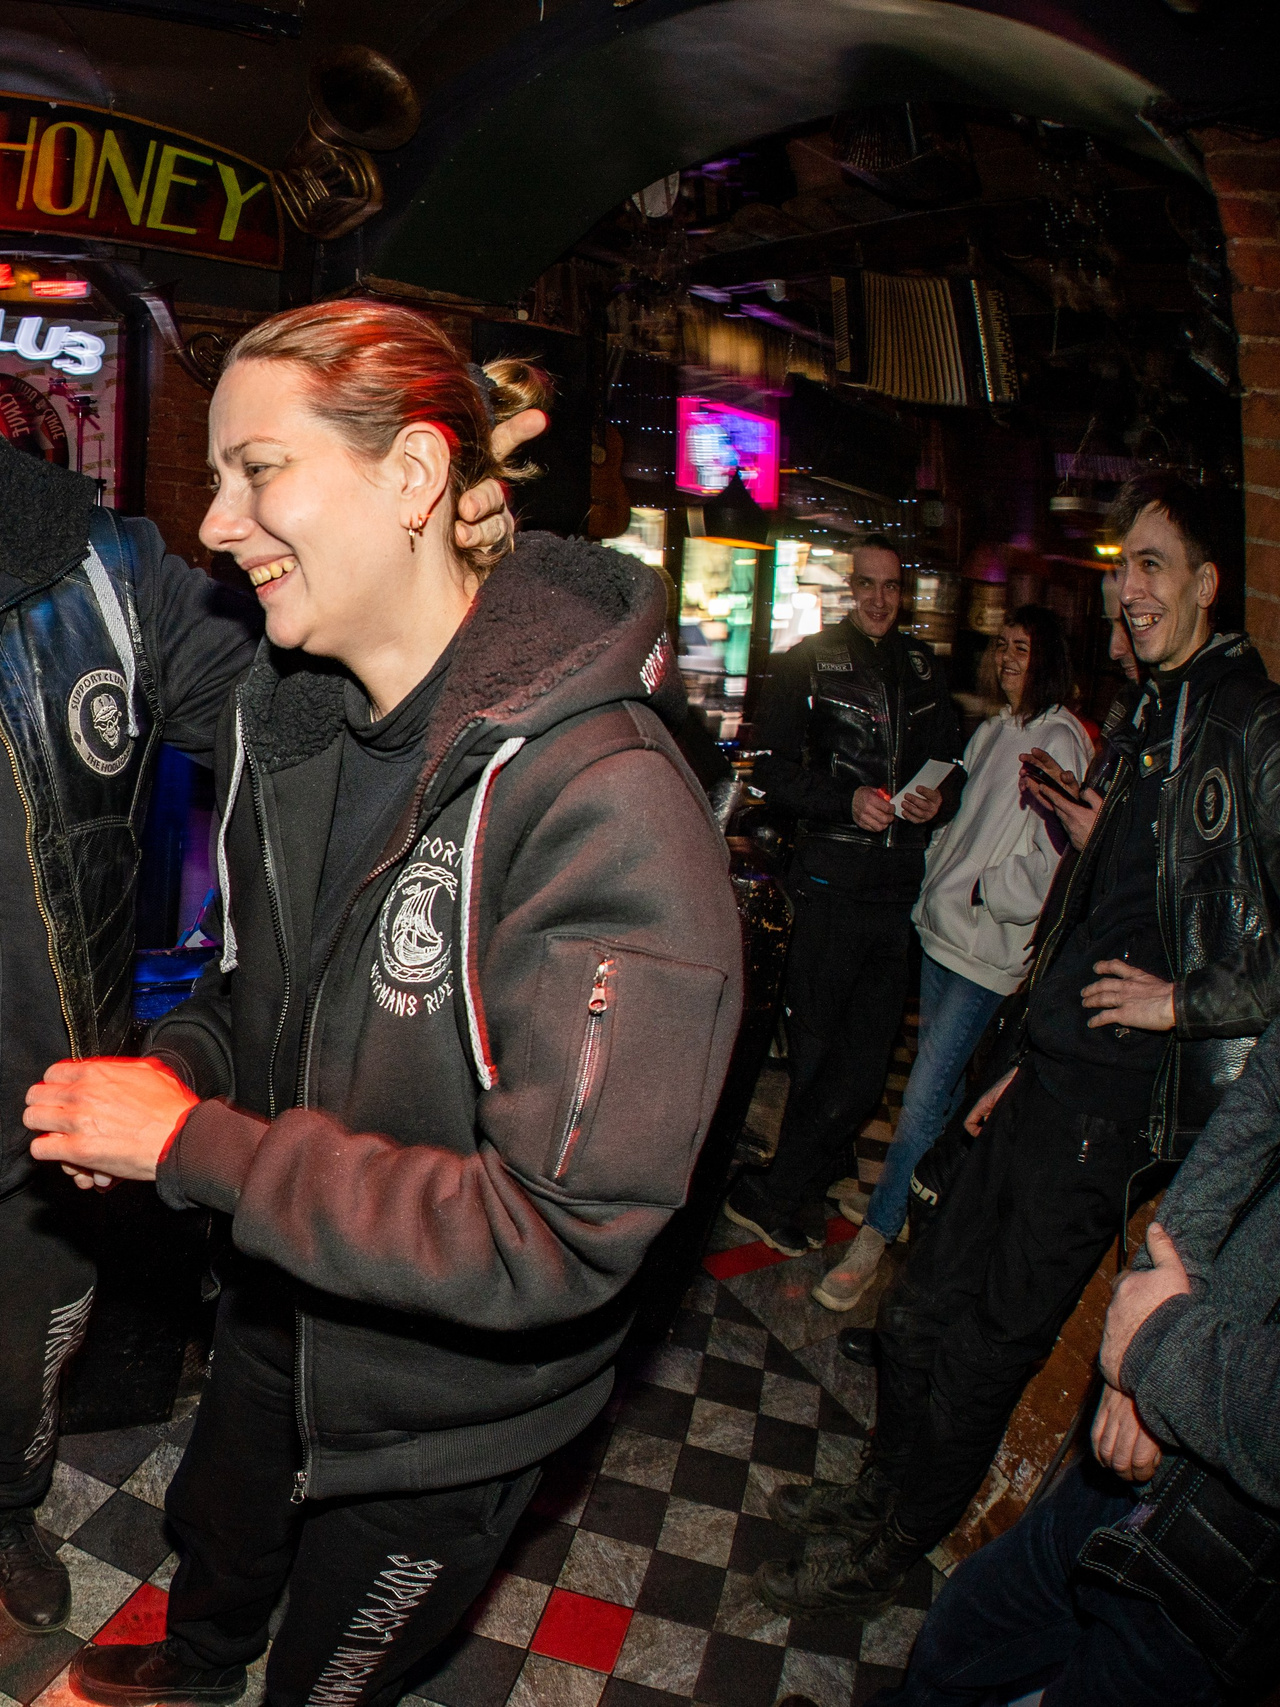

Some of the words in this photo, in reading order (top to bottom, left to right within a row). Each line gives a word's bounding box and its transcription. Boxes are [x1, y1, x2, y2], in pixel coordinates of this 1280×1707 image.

[71, 673, 102, 711] SUPPORT
[104, 673, 124, 688] CLUB
[86, 751, 100, 770] THE
[342, 1554, 444, 1645] SUPPORT
